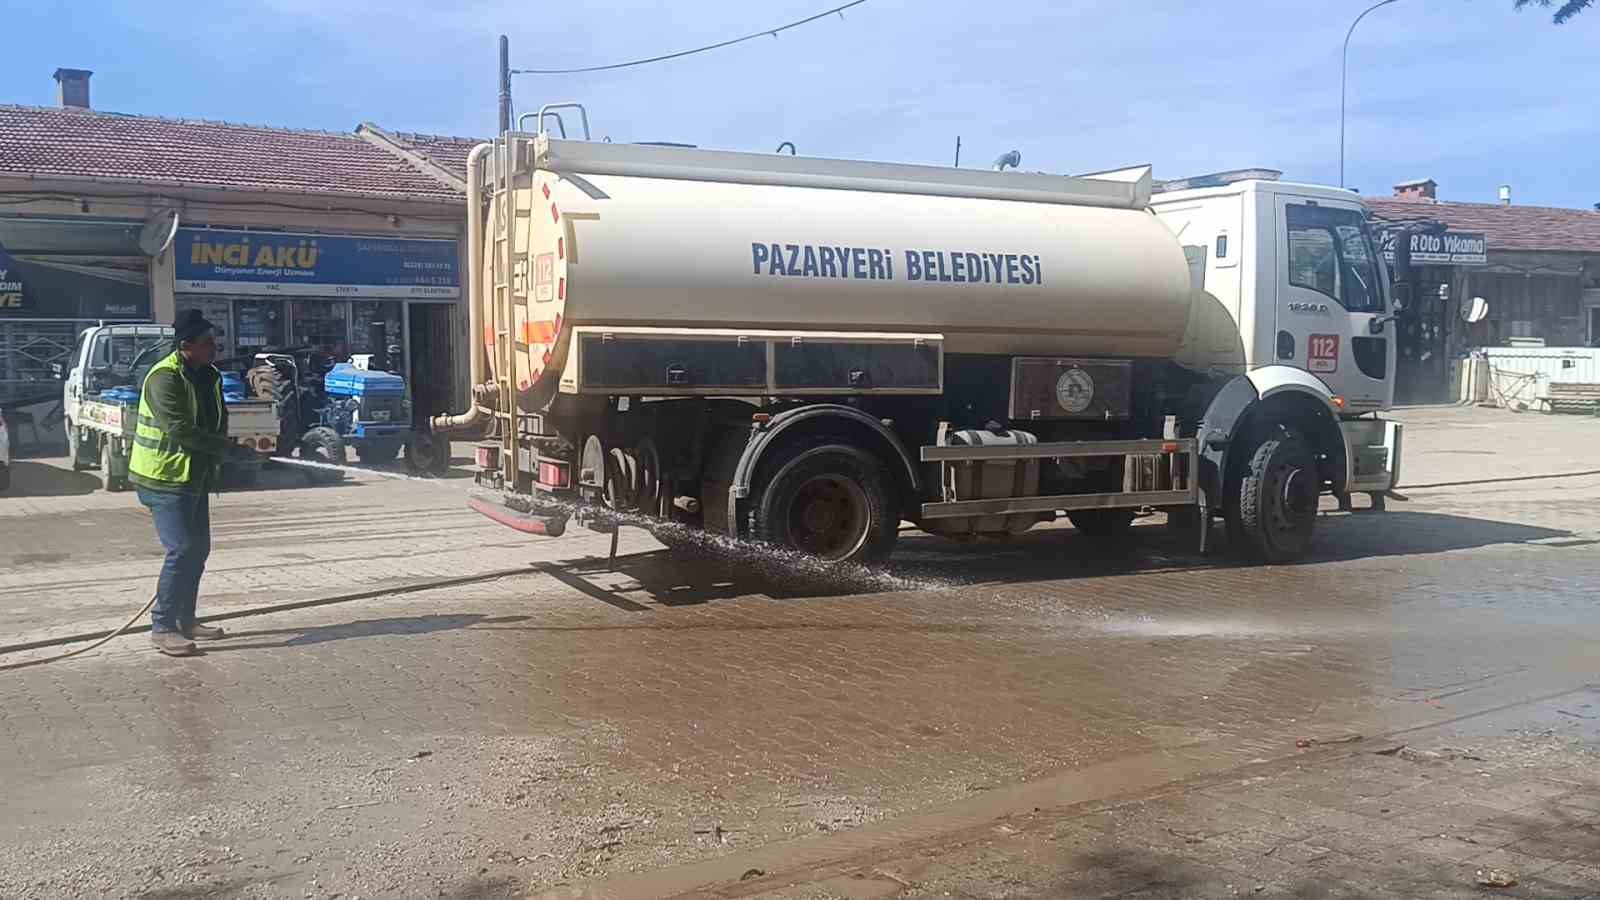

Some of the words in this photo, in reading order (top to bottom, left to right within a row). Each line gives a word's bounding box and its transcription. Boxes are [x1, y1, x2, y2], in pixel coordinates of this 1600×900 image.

[191, 235, 250, 265] İNCİ
[255, 239, 317, 269] AKÜ
[1420, 235, 1440, 251] Oto
[1444, 235, 1484, 253] Yıkama
[1313, 337, 1335, 357] 112
